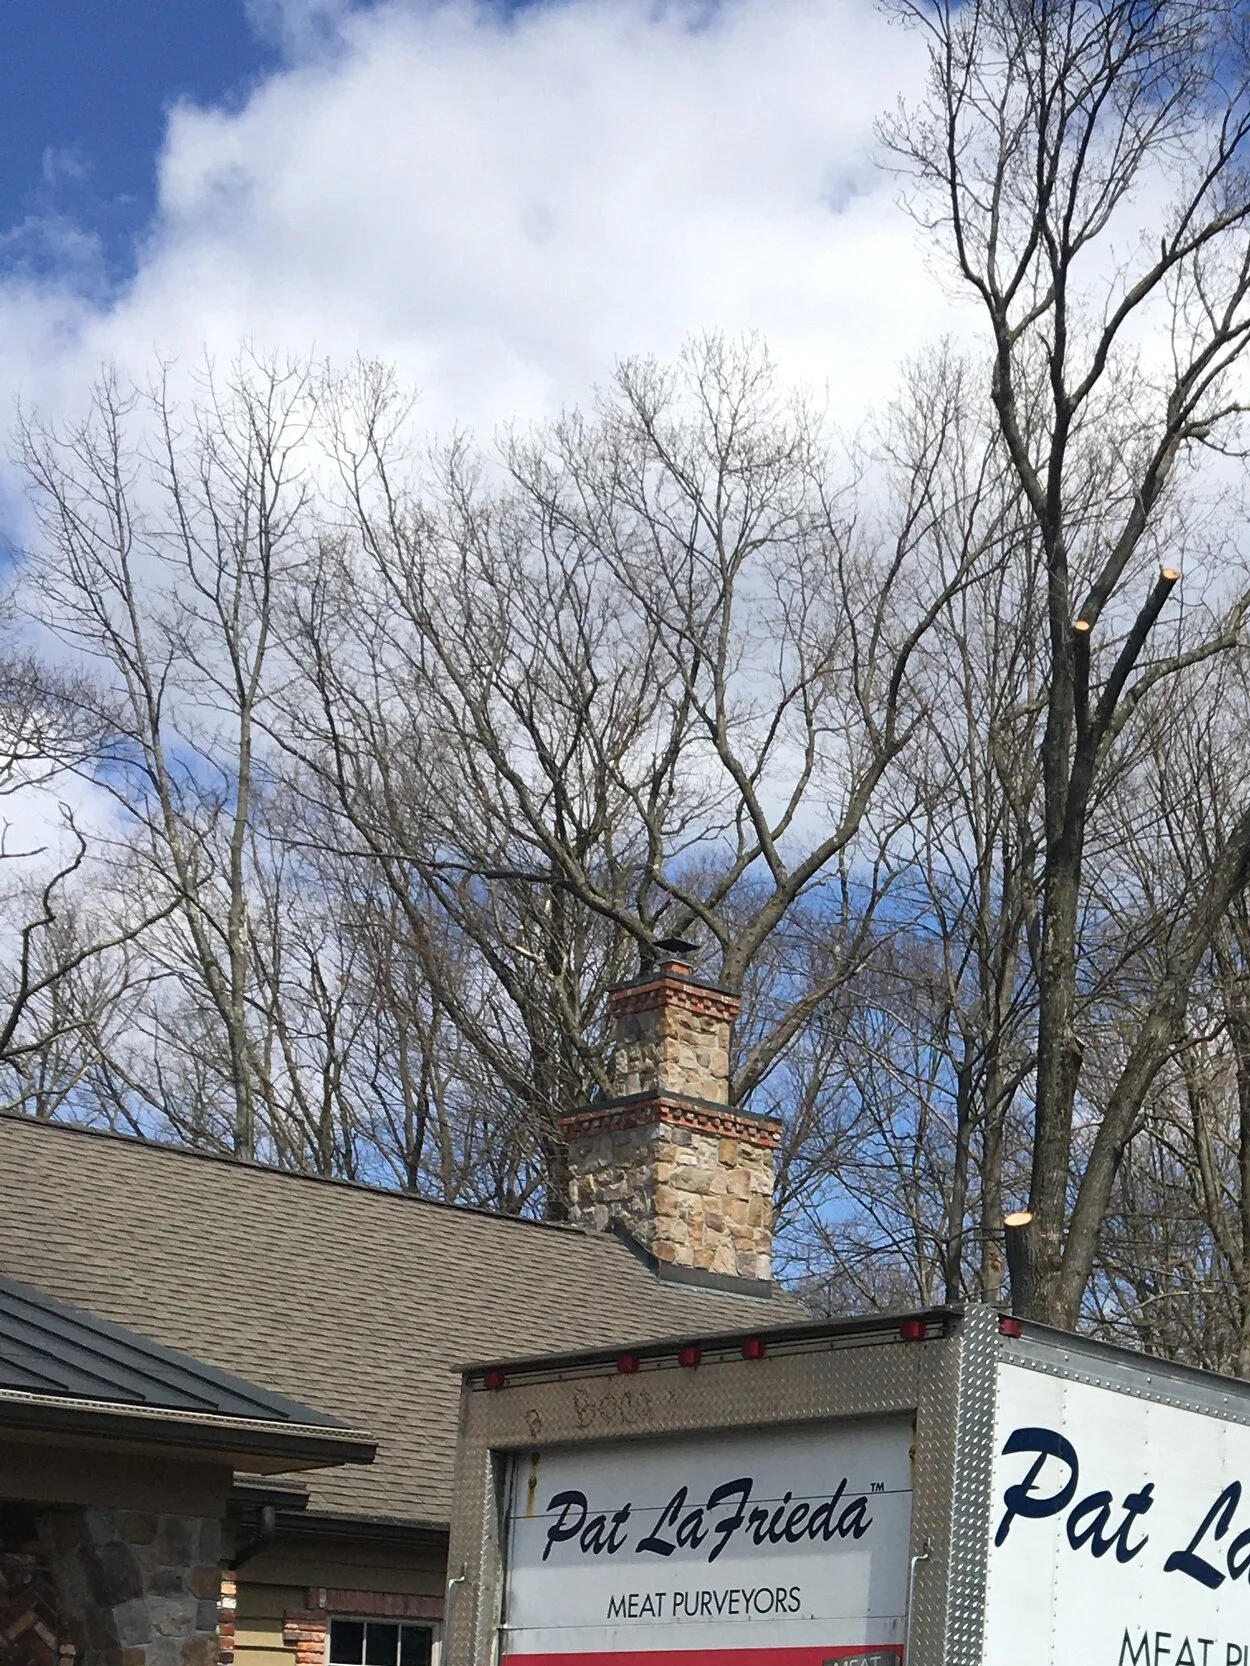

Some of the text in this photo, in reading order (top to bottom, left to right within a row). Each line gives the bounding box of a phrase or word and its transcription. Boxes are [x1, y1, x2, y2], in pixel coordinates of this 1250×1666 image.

[541, 1489, 632, 1562] Pat
[635, 1477, 874, 1564] LaFrieda
[994, 1427, 1156, 1564] Pat
[606, 1586, 802, 1619] MEAT PURVEYORS
